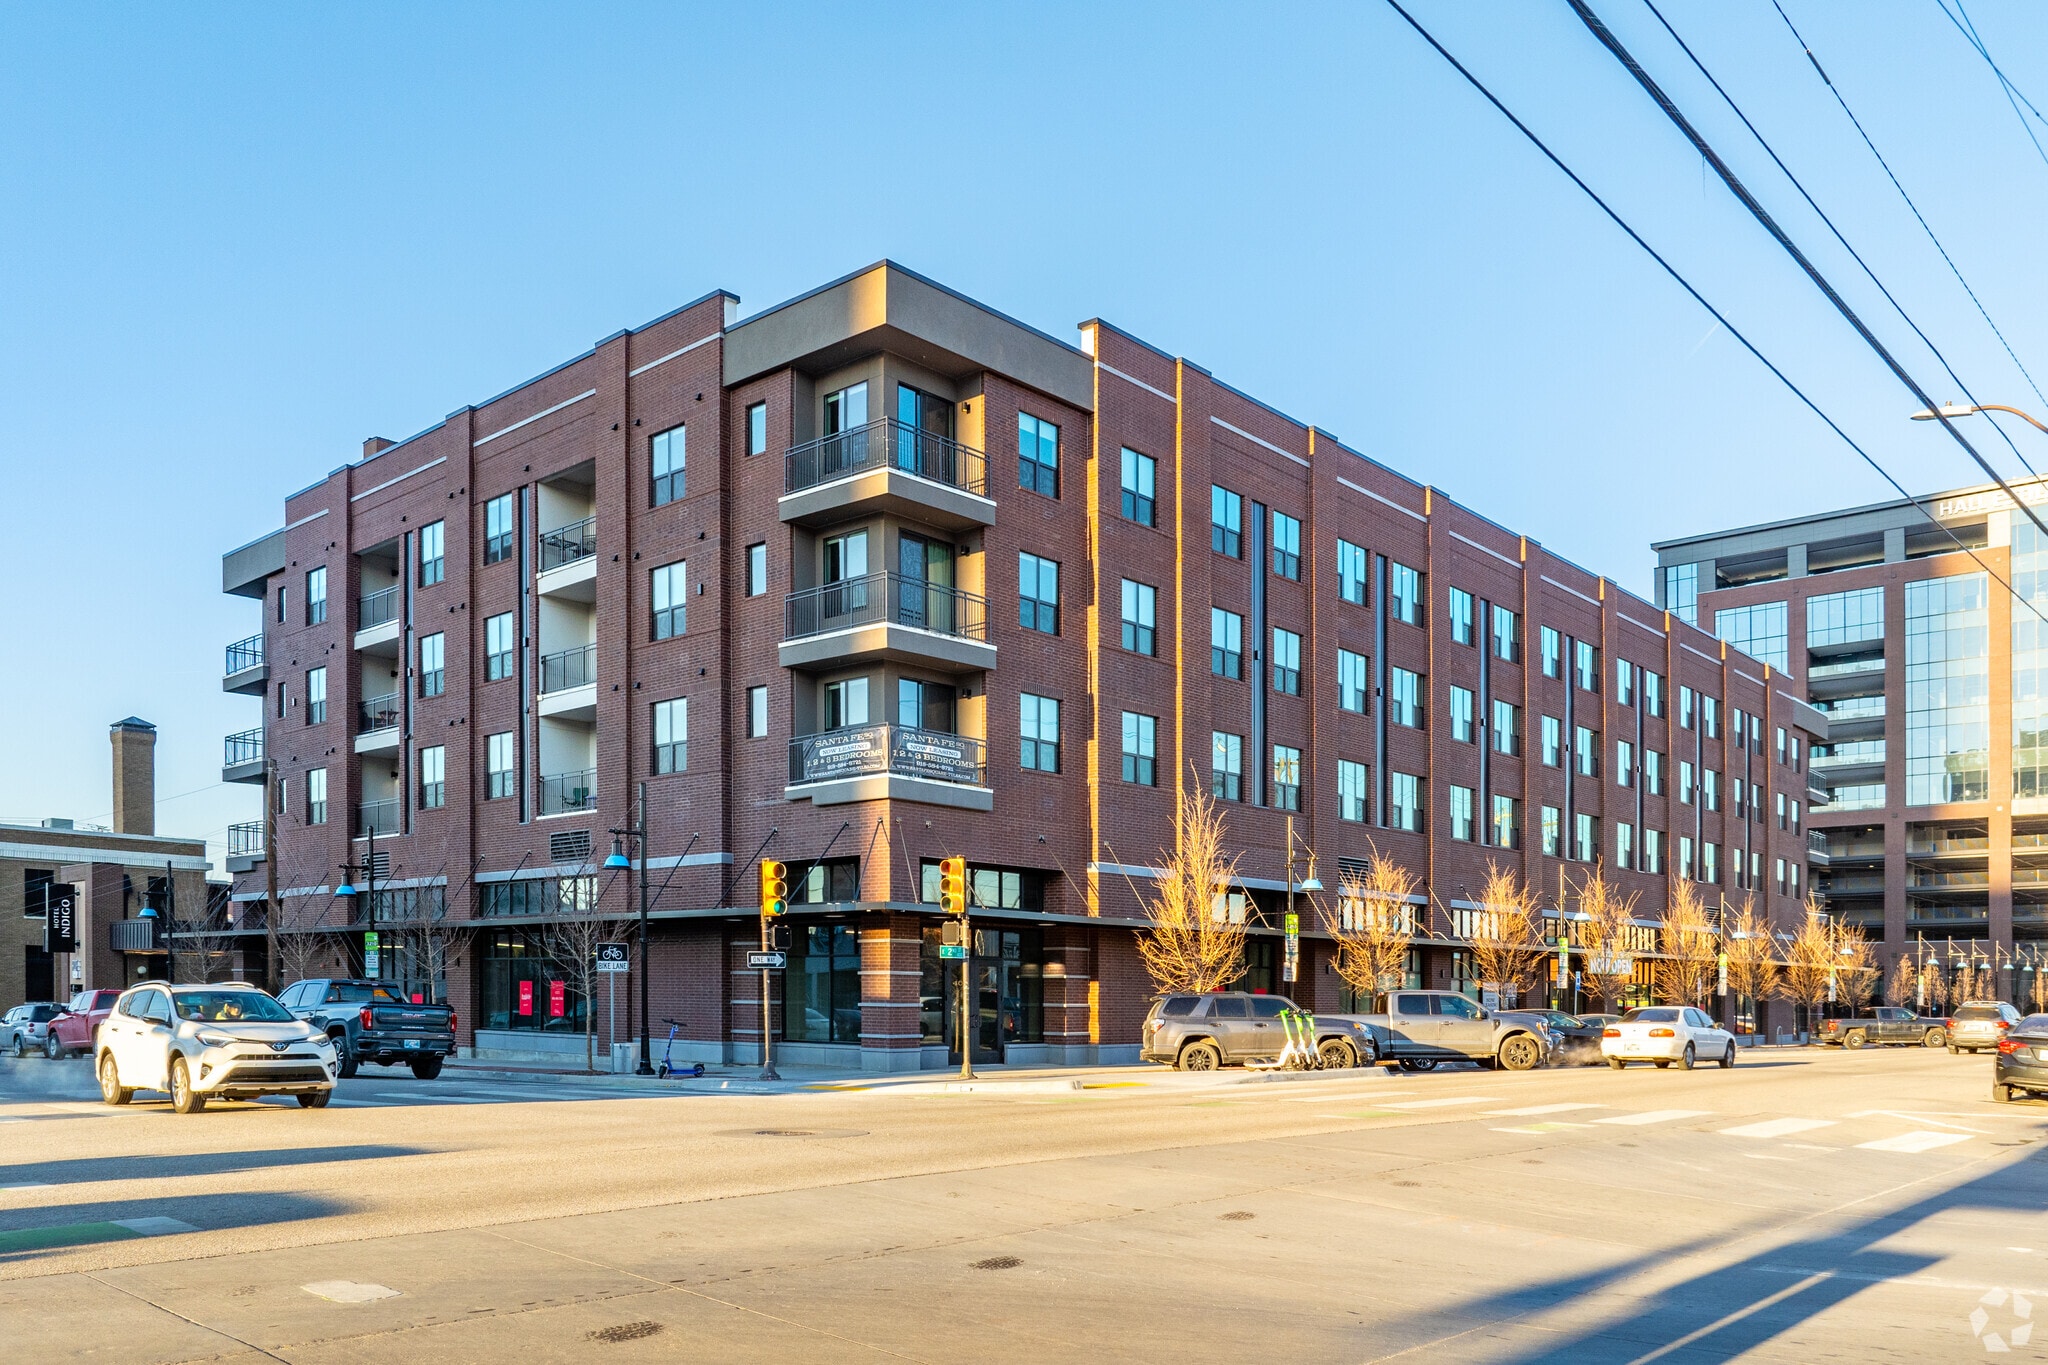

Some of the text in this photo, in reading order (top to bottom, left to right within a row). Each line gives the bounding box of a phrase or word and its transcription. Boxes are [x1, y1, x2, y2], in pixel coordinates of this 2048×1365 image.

[1940, 495, 1987, 517] HALL
[815, 735, 849, 748] SANTA
[850, 733, 864, 742] FE
[902, 732, 940, 746] SANTA
[941, 740, 955, 748] FE
[832, 748, 883, 762] BEDROOMS
[838, 744, 868, 752] LEASING
[929, 747, 958, 757] LEASING
[923, 754, 975, 769] BEDROOMS
[61, 899, 71, 938] INDIGO
[598, 962, 627, 970] BIKE LANE
[1611, 959, 1632, 974] OPEN
